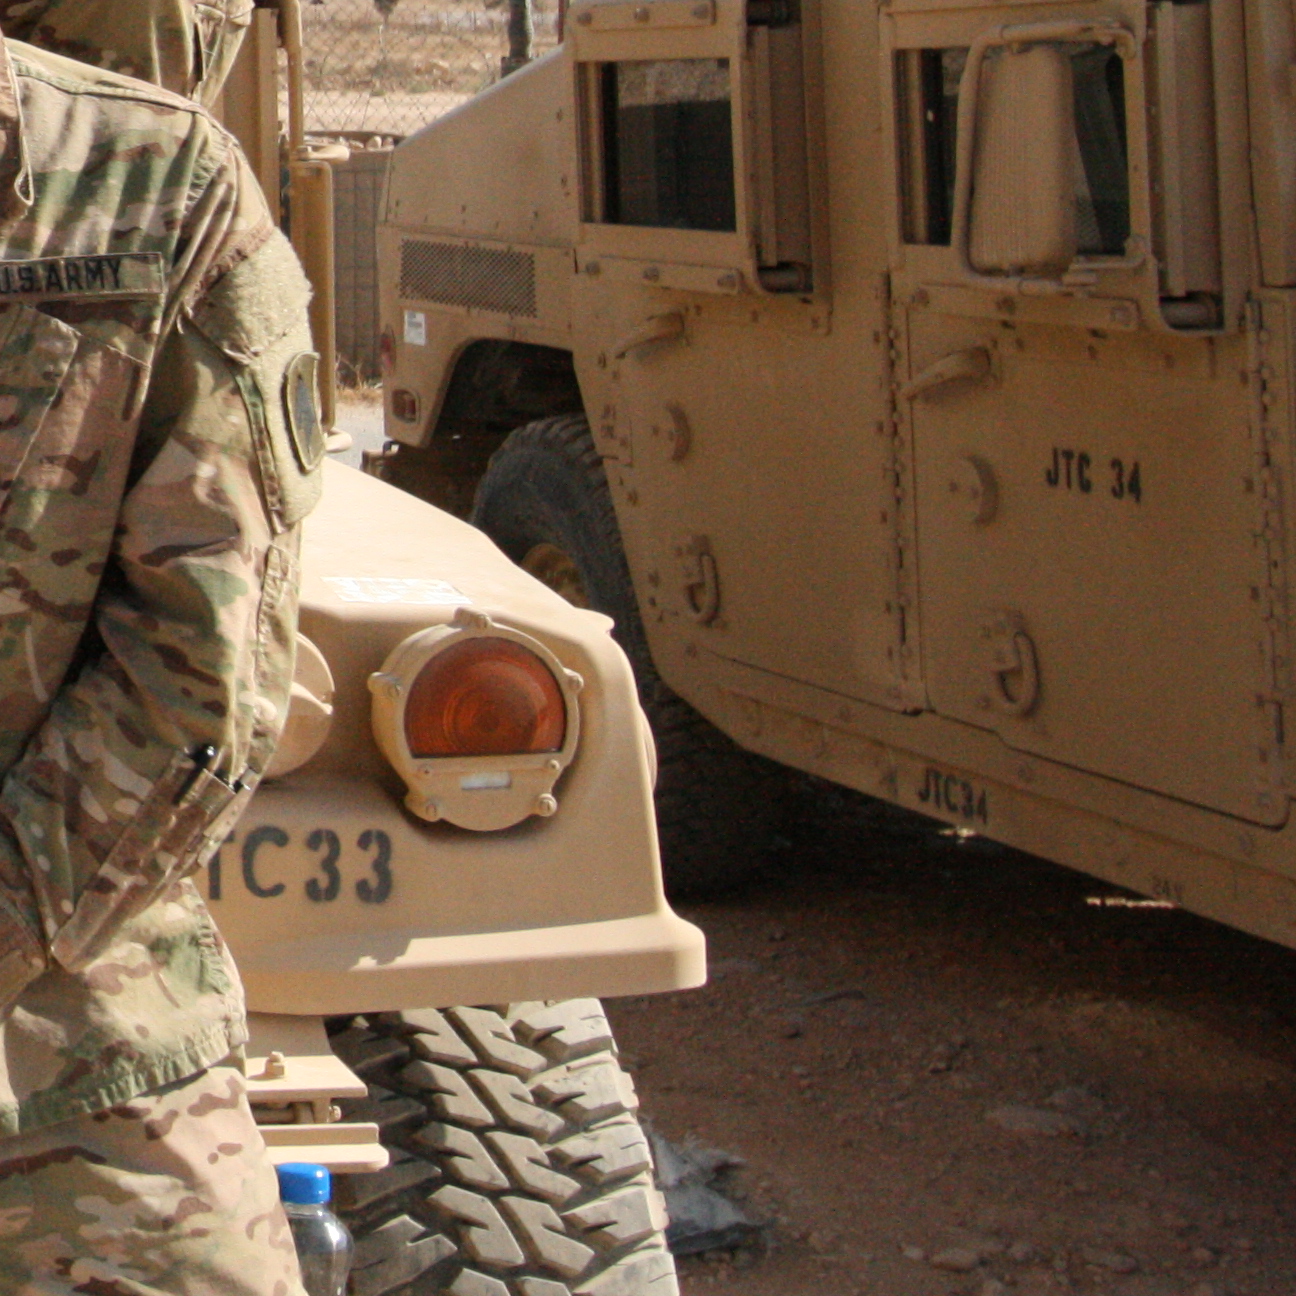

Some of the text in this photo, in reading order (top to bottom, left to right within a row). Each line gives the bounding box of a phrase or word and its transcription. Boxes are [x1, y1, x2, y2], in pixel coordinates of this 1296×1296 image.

[45, 257, 121, 292] ARMY
[1046, 447, 1142, 503] JTC 34
[917, 766, 989, 826] JTC34
[209, 825, 394, 904] TC33
